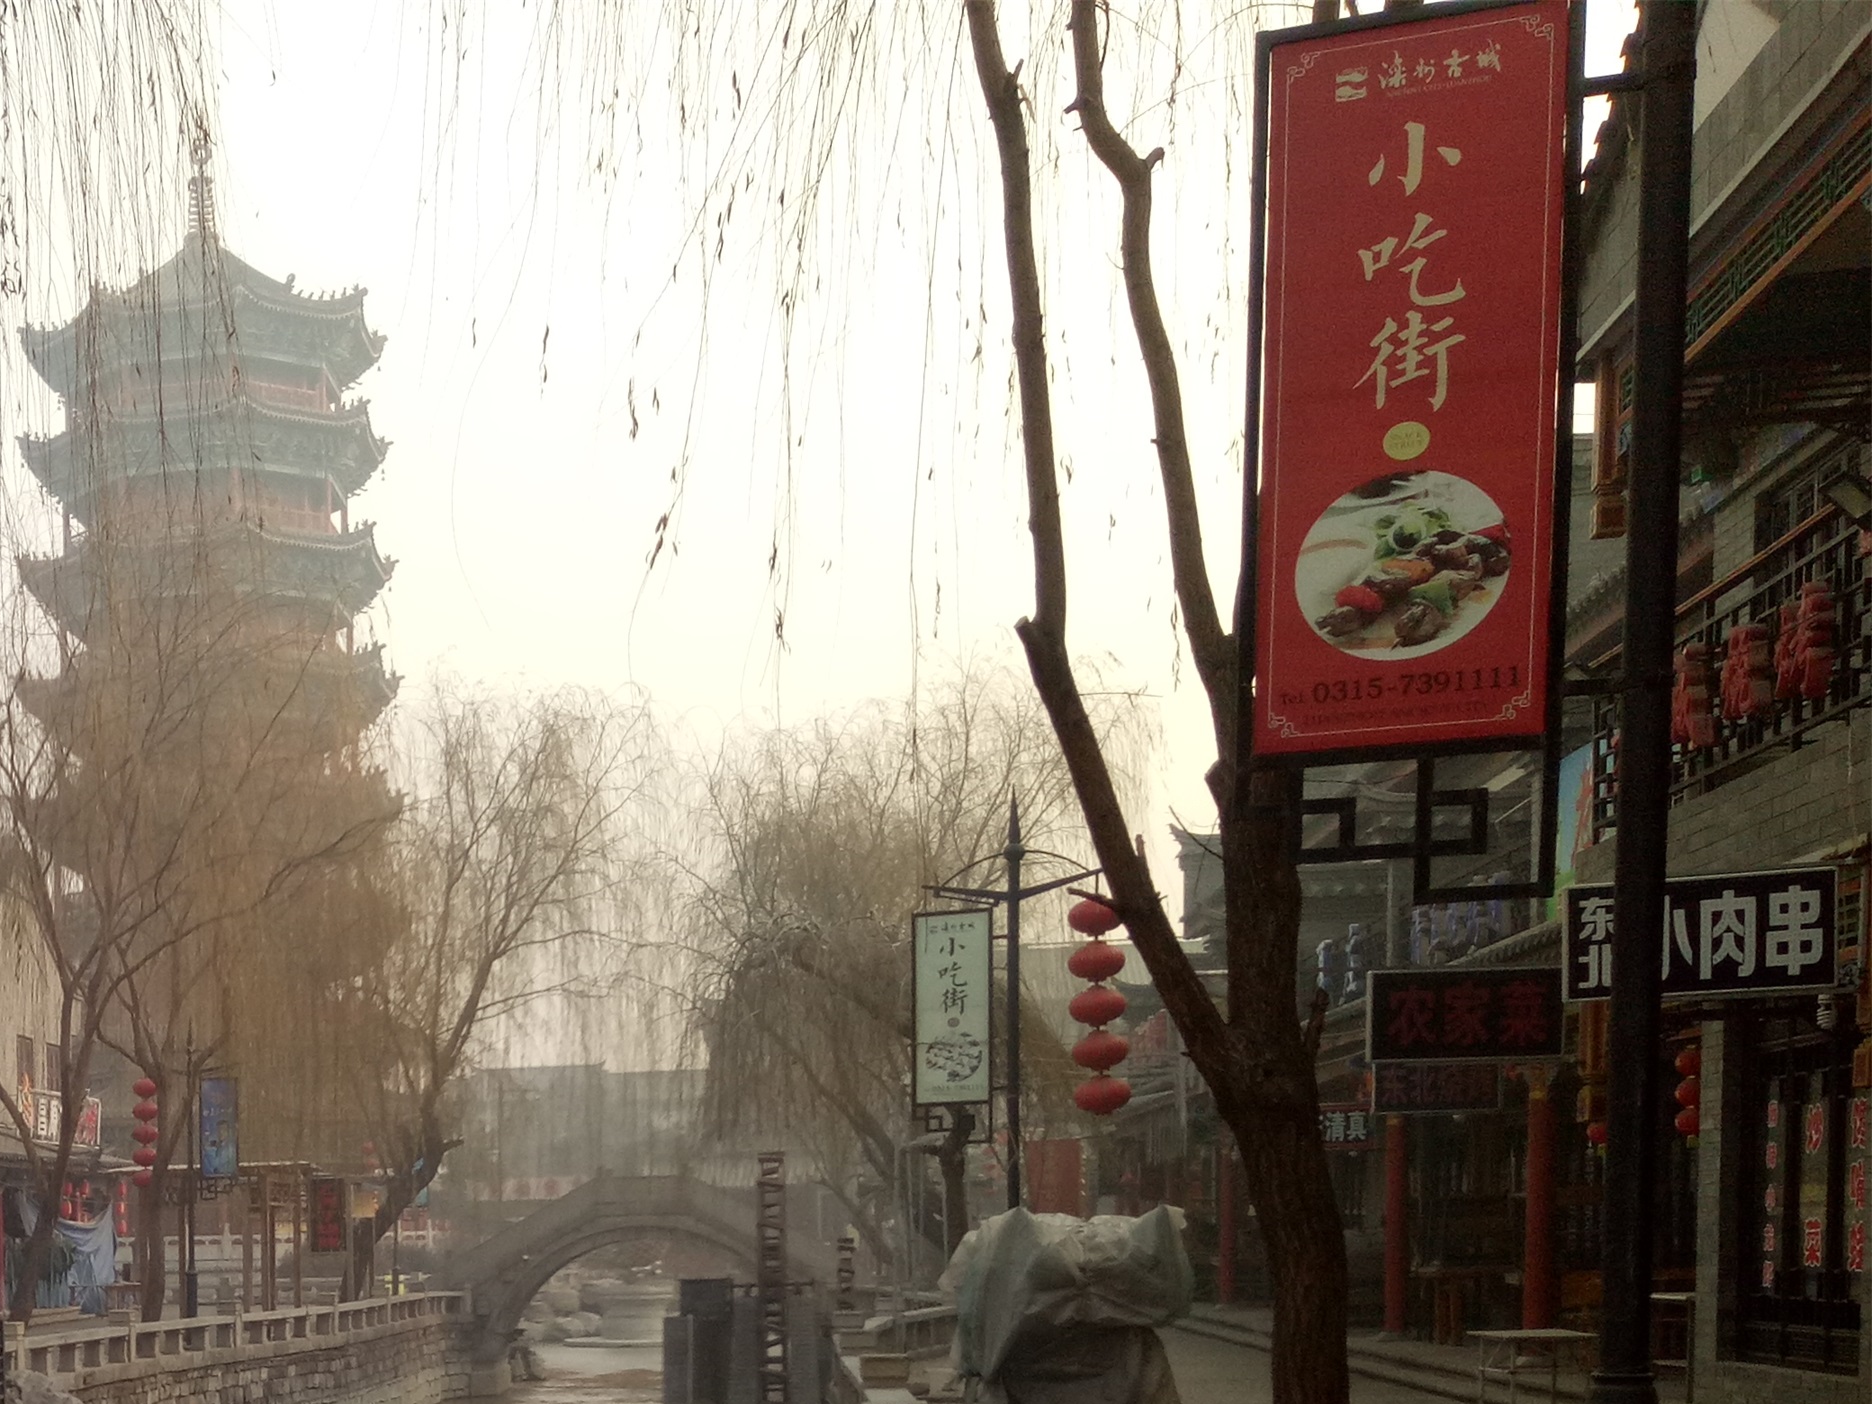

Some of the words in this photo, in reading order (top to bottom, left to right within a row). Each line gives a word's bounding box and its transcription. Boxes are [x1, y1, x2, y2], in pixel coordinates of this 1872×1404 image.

[1378, 38, 1501, 90] 滦州古城
[1353, 121, 1467, 412] 小吃街
[1312, 666, 1521, 704] 0315-7391111
[938, 937, 969, 1017] 小吃街
[1387, 979, 1548, 1049] 农家菜
[1318, 1110, 1368, 1142] 清真
[1804, 1102, 1824, 1268] 炒菜
